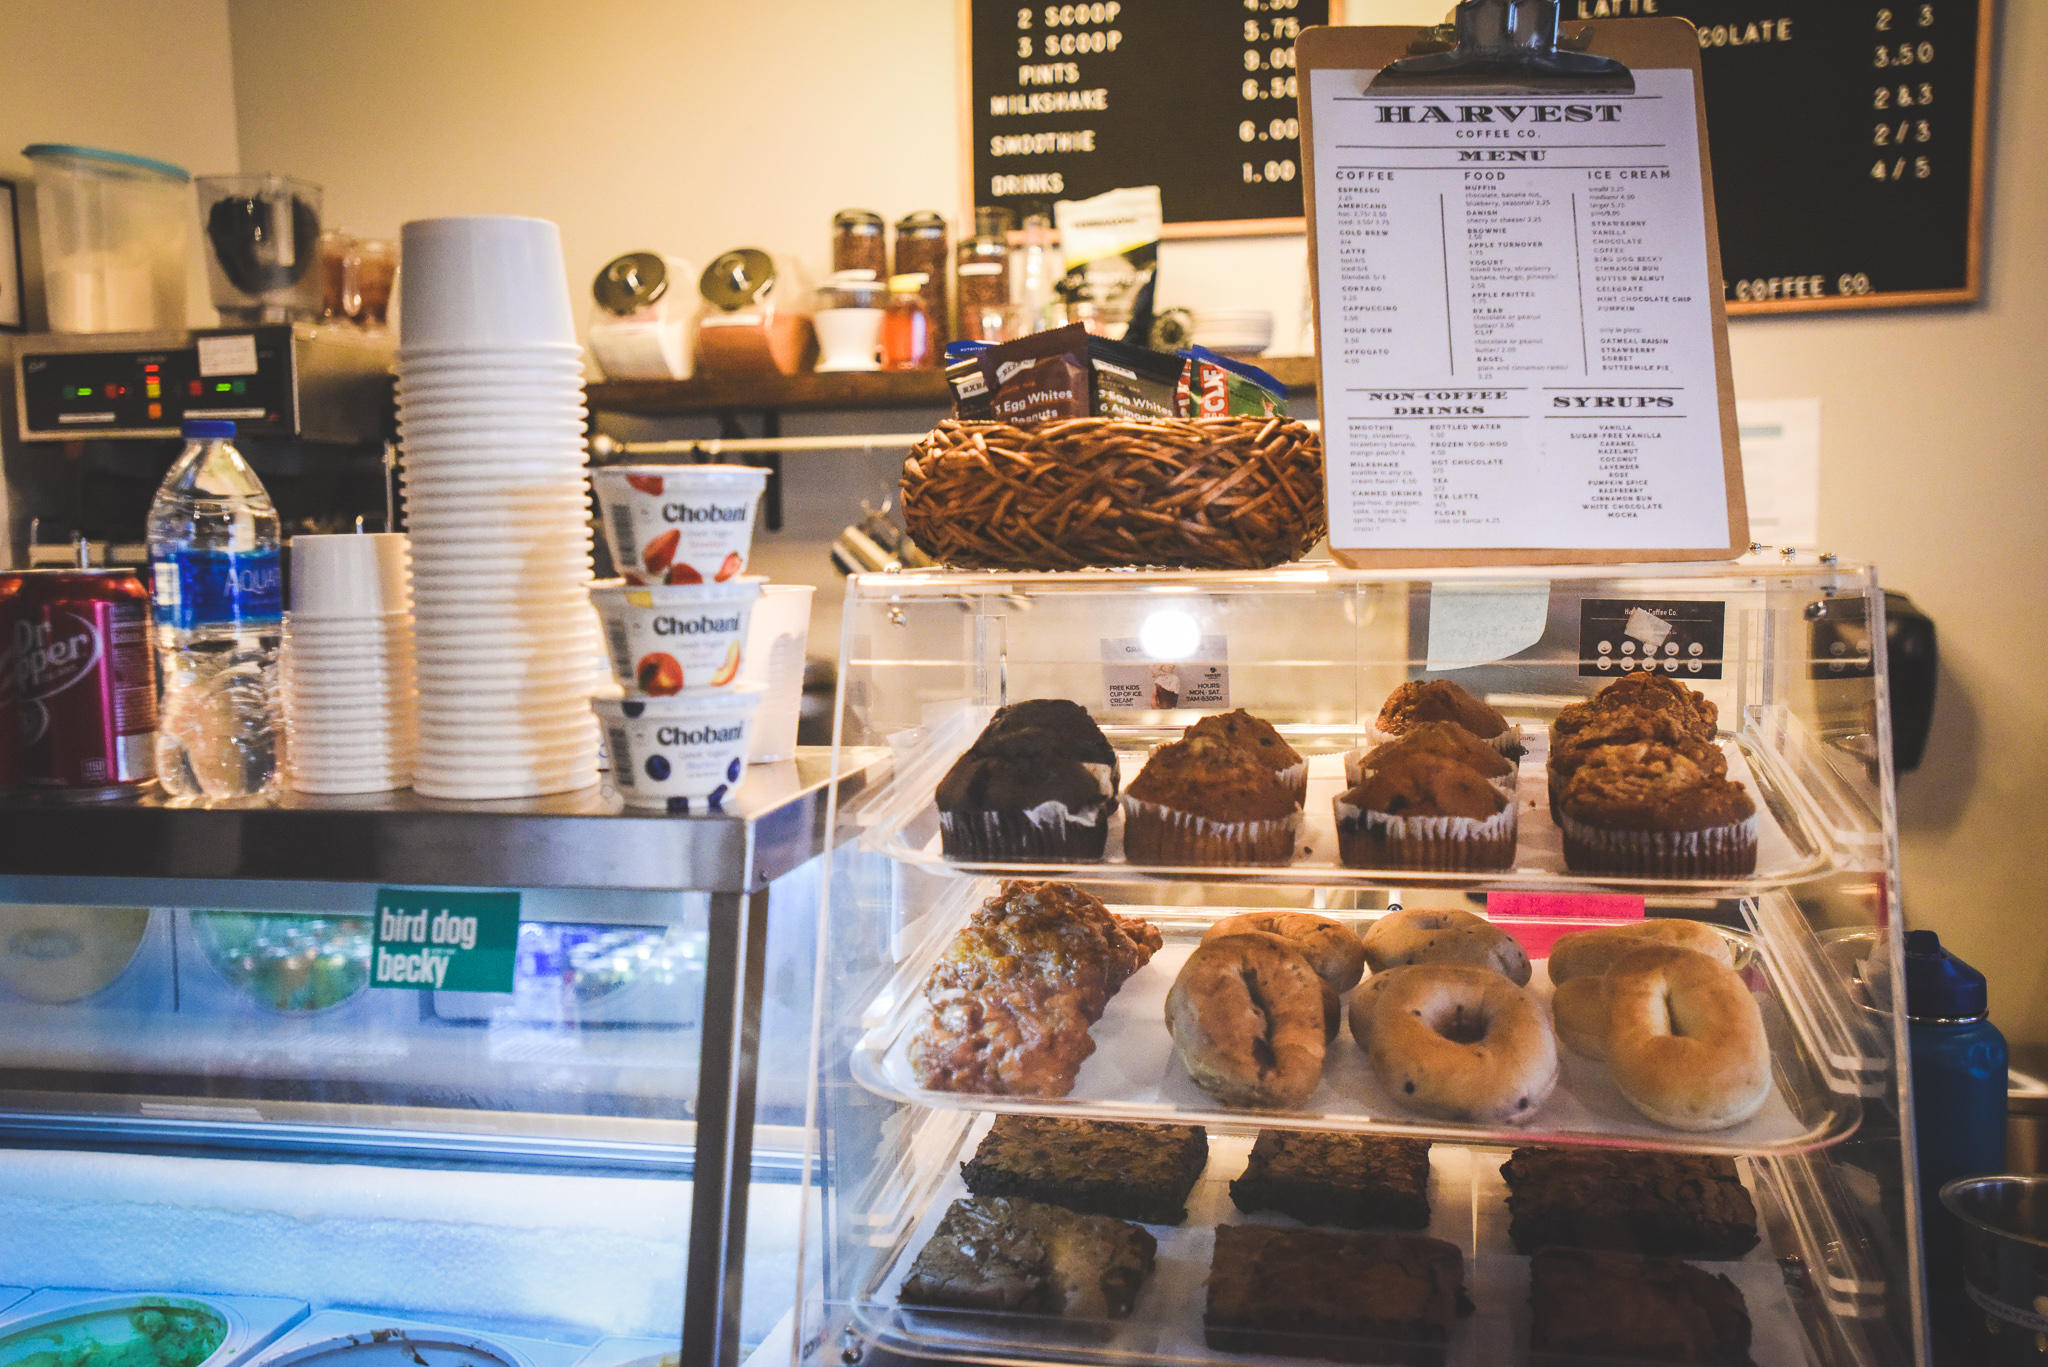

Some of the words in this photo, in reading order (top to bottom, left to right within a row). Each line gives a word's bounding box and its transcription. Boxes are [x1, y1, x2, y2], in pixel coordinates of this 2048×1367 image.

[1018, 8, 1033, 29] 2
[1045, 1, 1121, 27] SCOOP
[1875, 8, 1892, 31] 2
[1918, 4, 1935, 27] 3
[1243, 16, 1300, 42] 5.75
[1018, 36, 1033, 58] 3
[1045, 30, 1122, 57] SCOOP
[1874, 42, 1935, 68] 3.50
[1018, 62, 1080, 86] PINTS
[1242, 76, 1299, 101] 6.50
[1874, 86, 1890, 109] 2
[1918, 83, 1934, 106] 3
[990, 88, 1108, 117] MILKSHAKE
[1374, 104, 1622, 124] HARVEST
[1239, 117, 1299, 142] 6.00
[1456, 129, 1511, 140] COFFEE
[1517, 129, 1541, 140] CO.
[1874, 122, 1890, 146] 2
[1916, 119, 1931, 143] 3
[990, 130, 1096, 157] SMOOTHIE
[1457, 150, 1547, 162] MENU
[1242, 160, 1296, 184] 1.00
[1335, 171, 1395, 182] COFFEE
[1464, 171, 1505, 181] FOOD
[1588, 171, 1612, 181] ICE
[1619, 170, 1671, 180] CREAM
[1870, 159, 1887, 181] 4
[1914, 155, 1931, 179] 5
[991, 172, 1064, 197] DRINKS
[1337, 202, 1388, 210] AMERICANO
[1736, 275, 1824, 302] COFFEE
[1003, 400, 1027, 413] Egg
[1028, 389, 1073, 405] Whites
[1132, 397, 1174, 417] Whites
[1368, 391, 1508, 401] NON-COFFEE
[1552, 395, 1674, 408] SYRUPS
[1392, 406, 1485, 415] DRINKS
[662, 502, 749, 523] Chobani
[653, 612, 741, 635] Chobani
[656, 721, 745, 746] Chobani
[380, 907, 428, 943] bird
[431, 909, 477, 950] dog
[377, 946, 450, 989] becky
